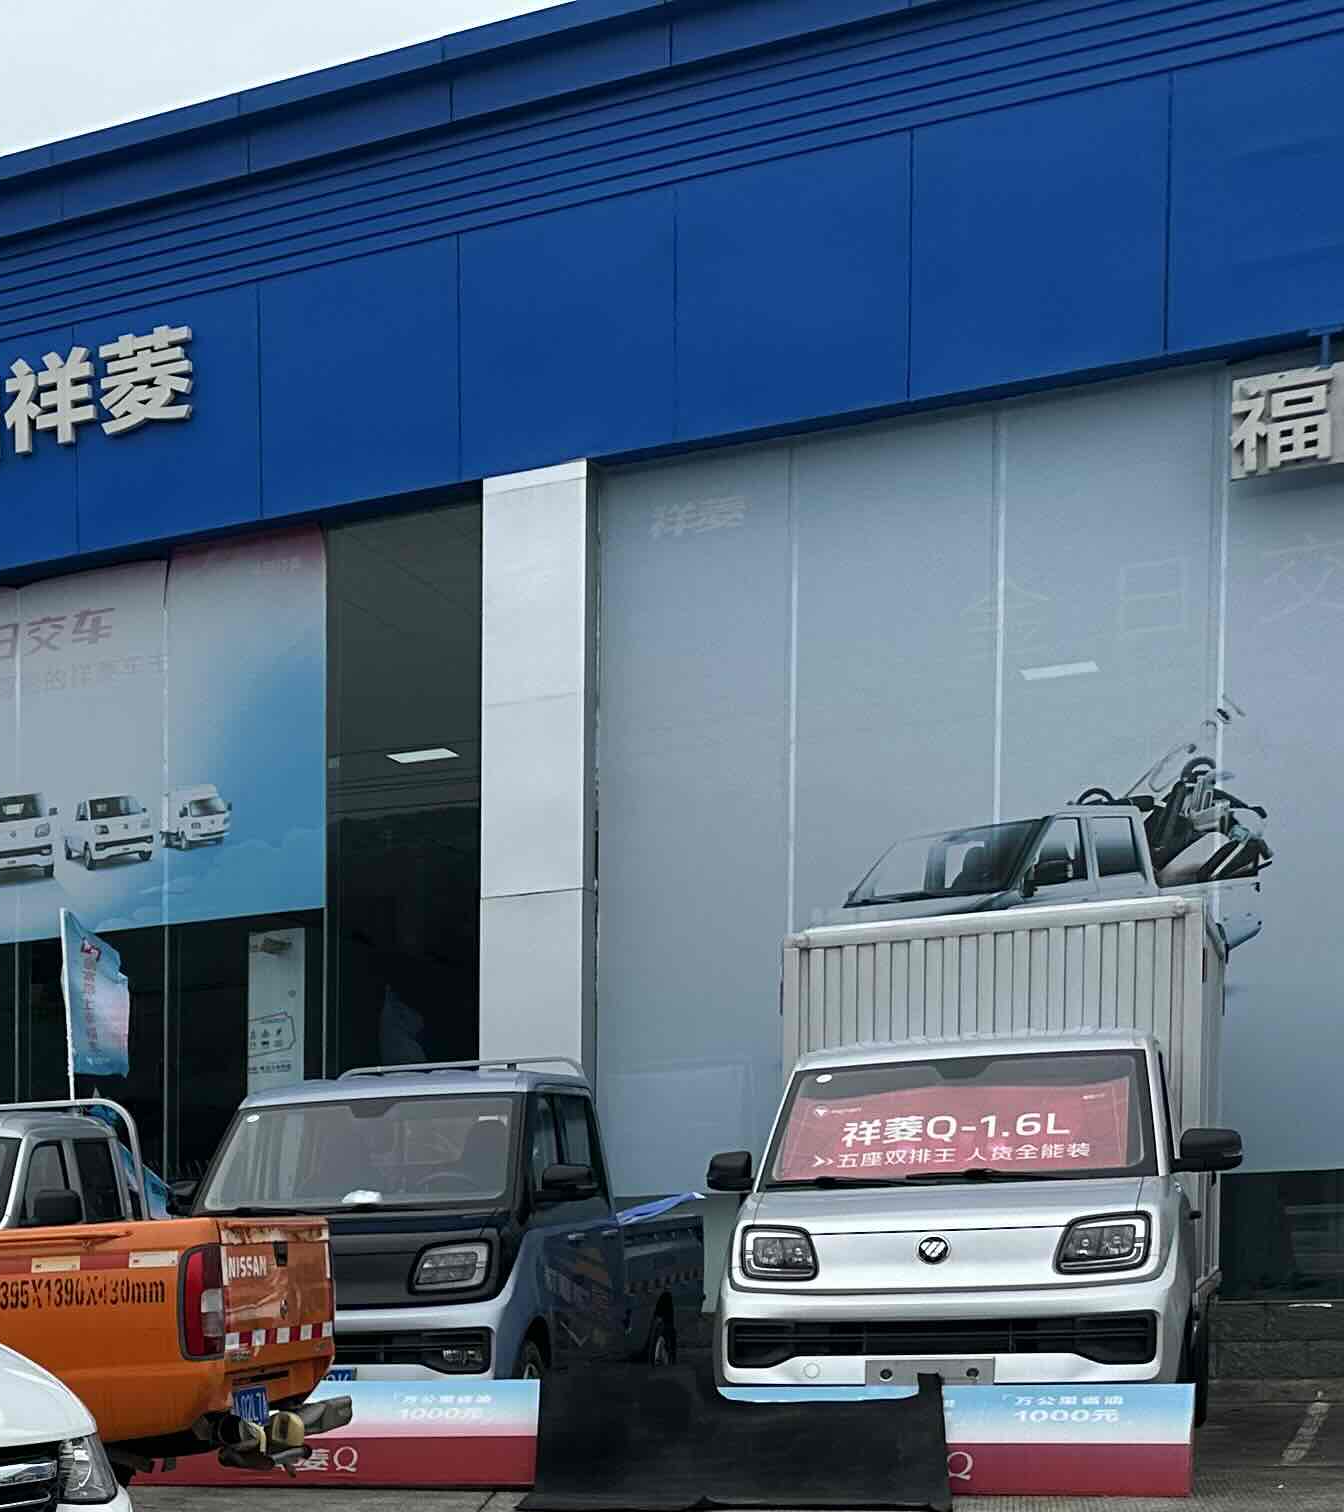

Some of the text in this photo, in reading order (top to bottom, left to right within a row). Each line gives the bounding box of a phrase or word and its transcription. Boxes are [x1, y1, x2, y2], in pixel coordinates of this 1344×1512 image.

[841, 1112, 1071, 1148] 祥菱Q-1.6L
[837, 1142, 1090, 1169] 五座双排王 人货全能装
[227, 1255, 267, 1280] NISSAN
[1014, 1409, 1120, 1423] 1000元
[947, 1451, 974, 1480] Q
